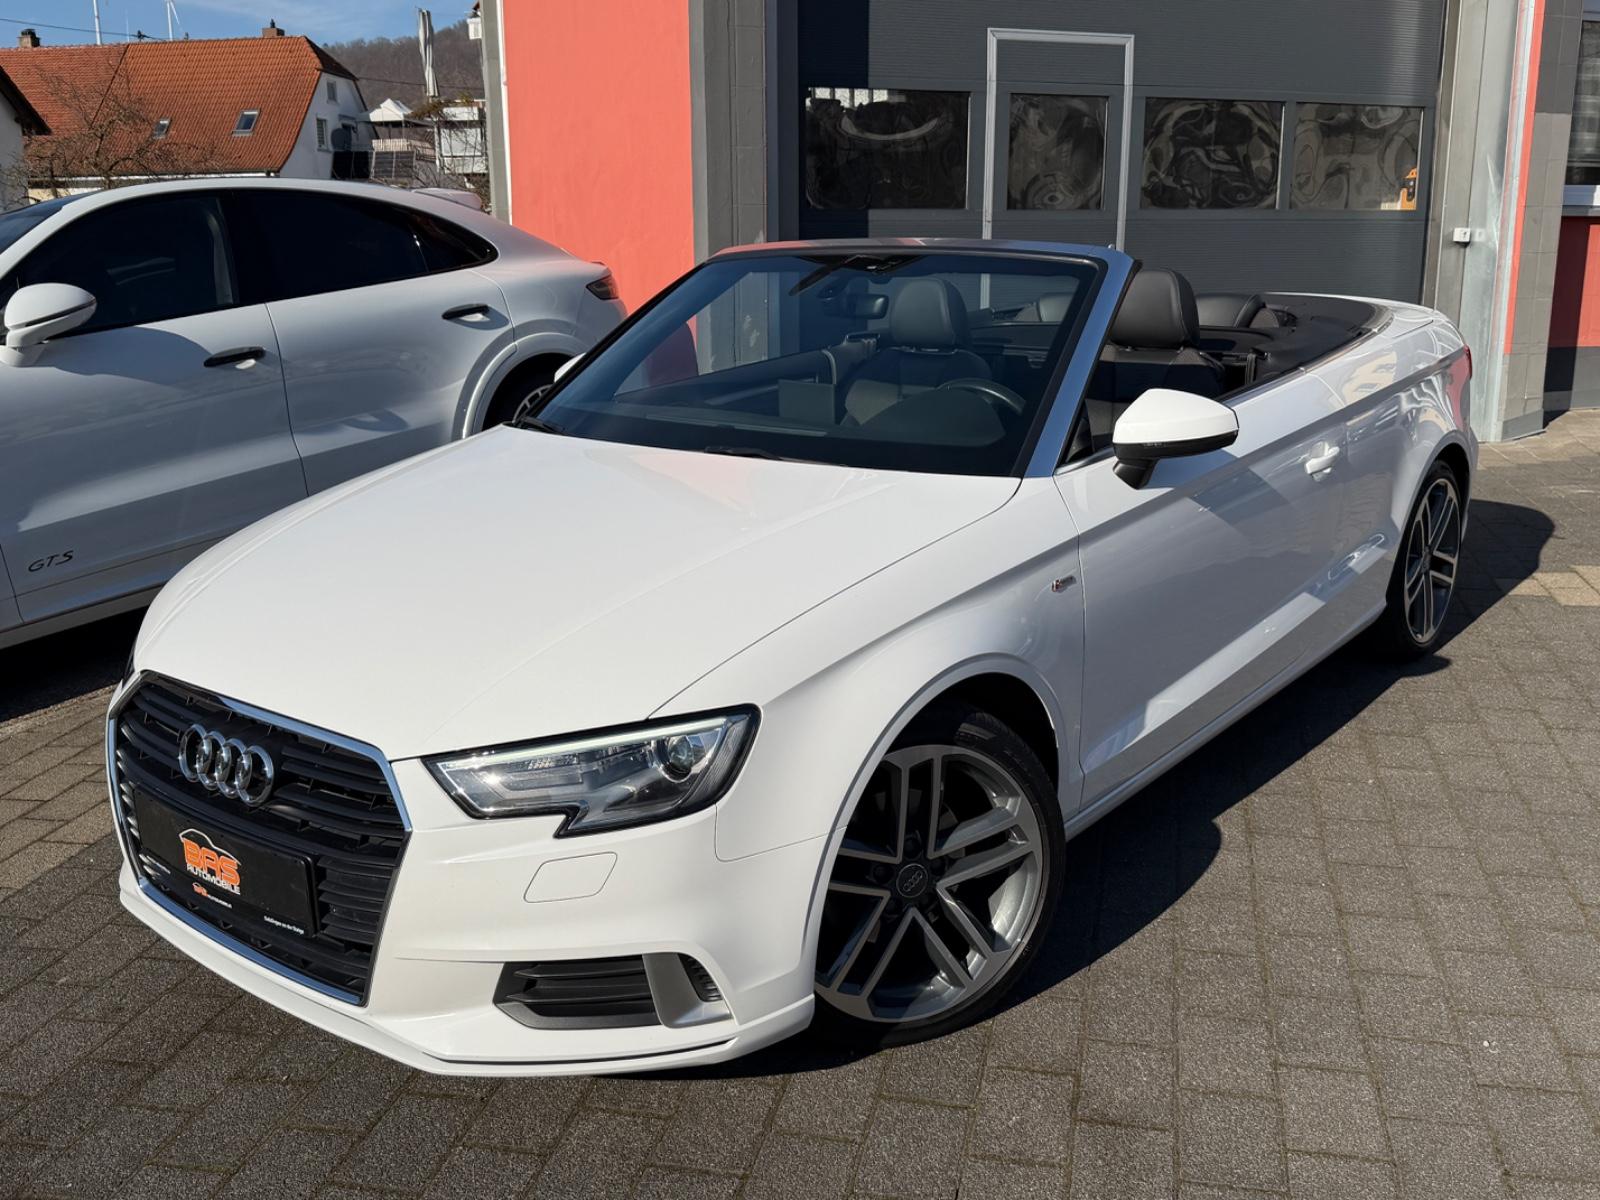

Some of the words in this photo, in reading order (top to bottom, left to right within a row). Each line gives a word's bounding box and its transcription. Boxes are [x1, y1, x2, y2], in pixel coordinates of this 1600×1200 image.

[28, 550, 74, 572] GTS
[183, 838, 240, 885] BAS
[187, 864, 240, 895] AUTOMOBILE
